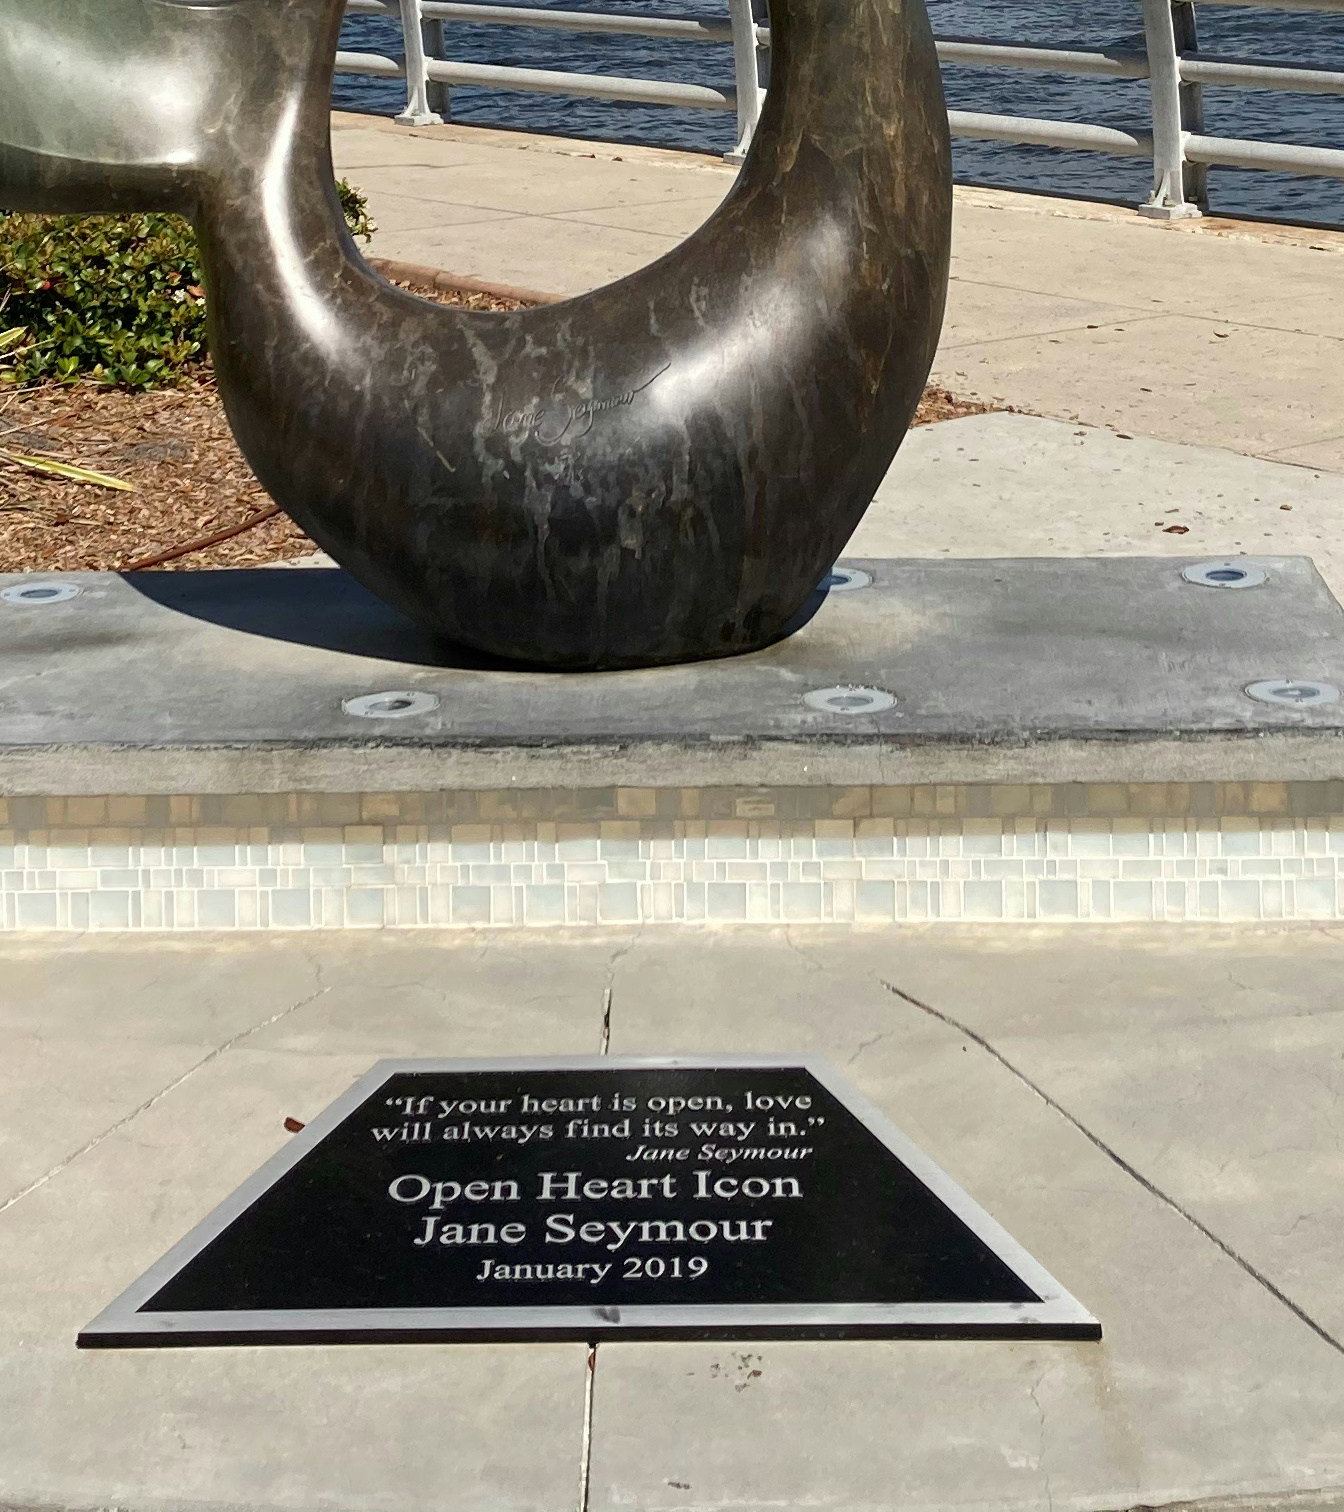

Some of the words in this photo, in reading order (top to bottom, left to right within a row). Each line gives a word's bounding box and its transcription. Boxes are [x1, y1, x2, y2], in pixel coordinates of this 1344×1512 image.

[437, 1099, 513, 1119] your
[521, 1094, 601, 1114] heart
[612, 1092, 637, 1112] is
[647, 1096, 733, 1116] open,
[745, 1090, 812, 1111] love
[371, 1121, 432, 1142] will
[442, 1121, 554, 1144] always
[566, 1118, 631, 1138] find
[643, 1117, 679, 1138] its
[690, 1122, 756, 1141] way
[625, 1144, 690, 1161] Jane
[697, 1143, 813, 1164] Seymour
[388, 1174, 521, 1210] Open
[536, 1171, 677, 1200] Heart
[692, 1170, 804, 1201] Icon
[413, 1216, 528, 1245] Jane
[544, 1213, 773, 1251] Seymour
[476, 1259, 613, 1284] January
[622, 1256, 709, 1279] 2019
